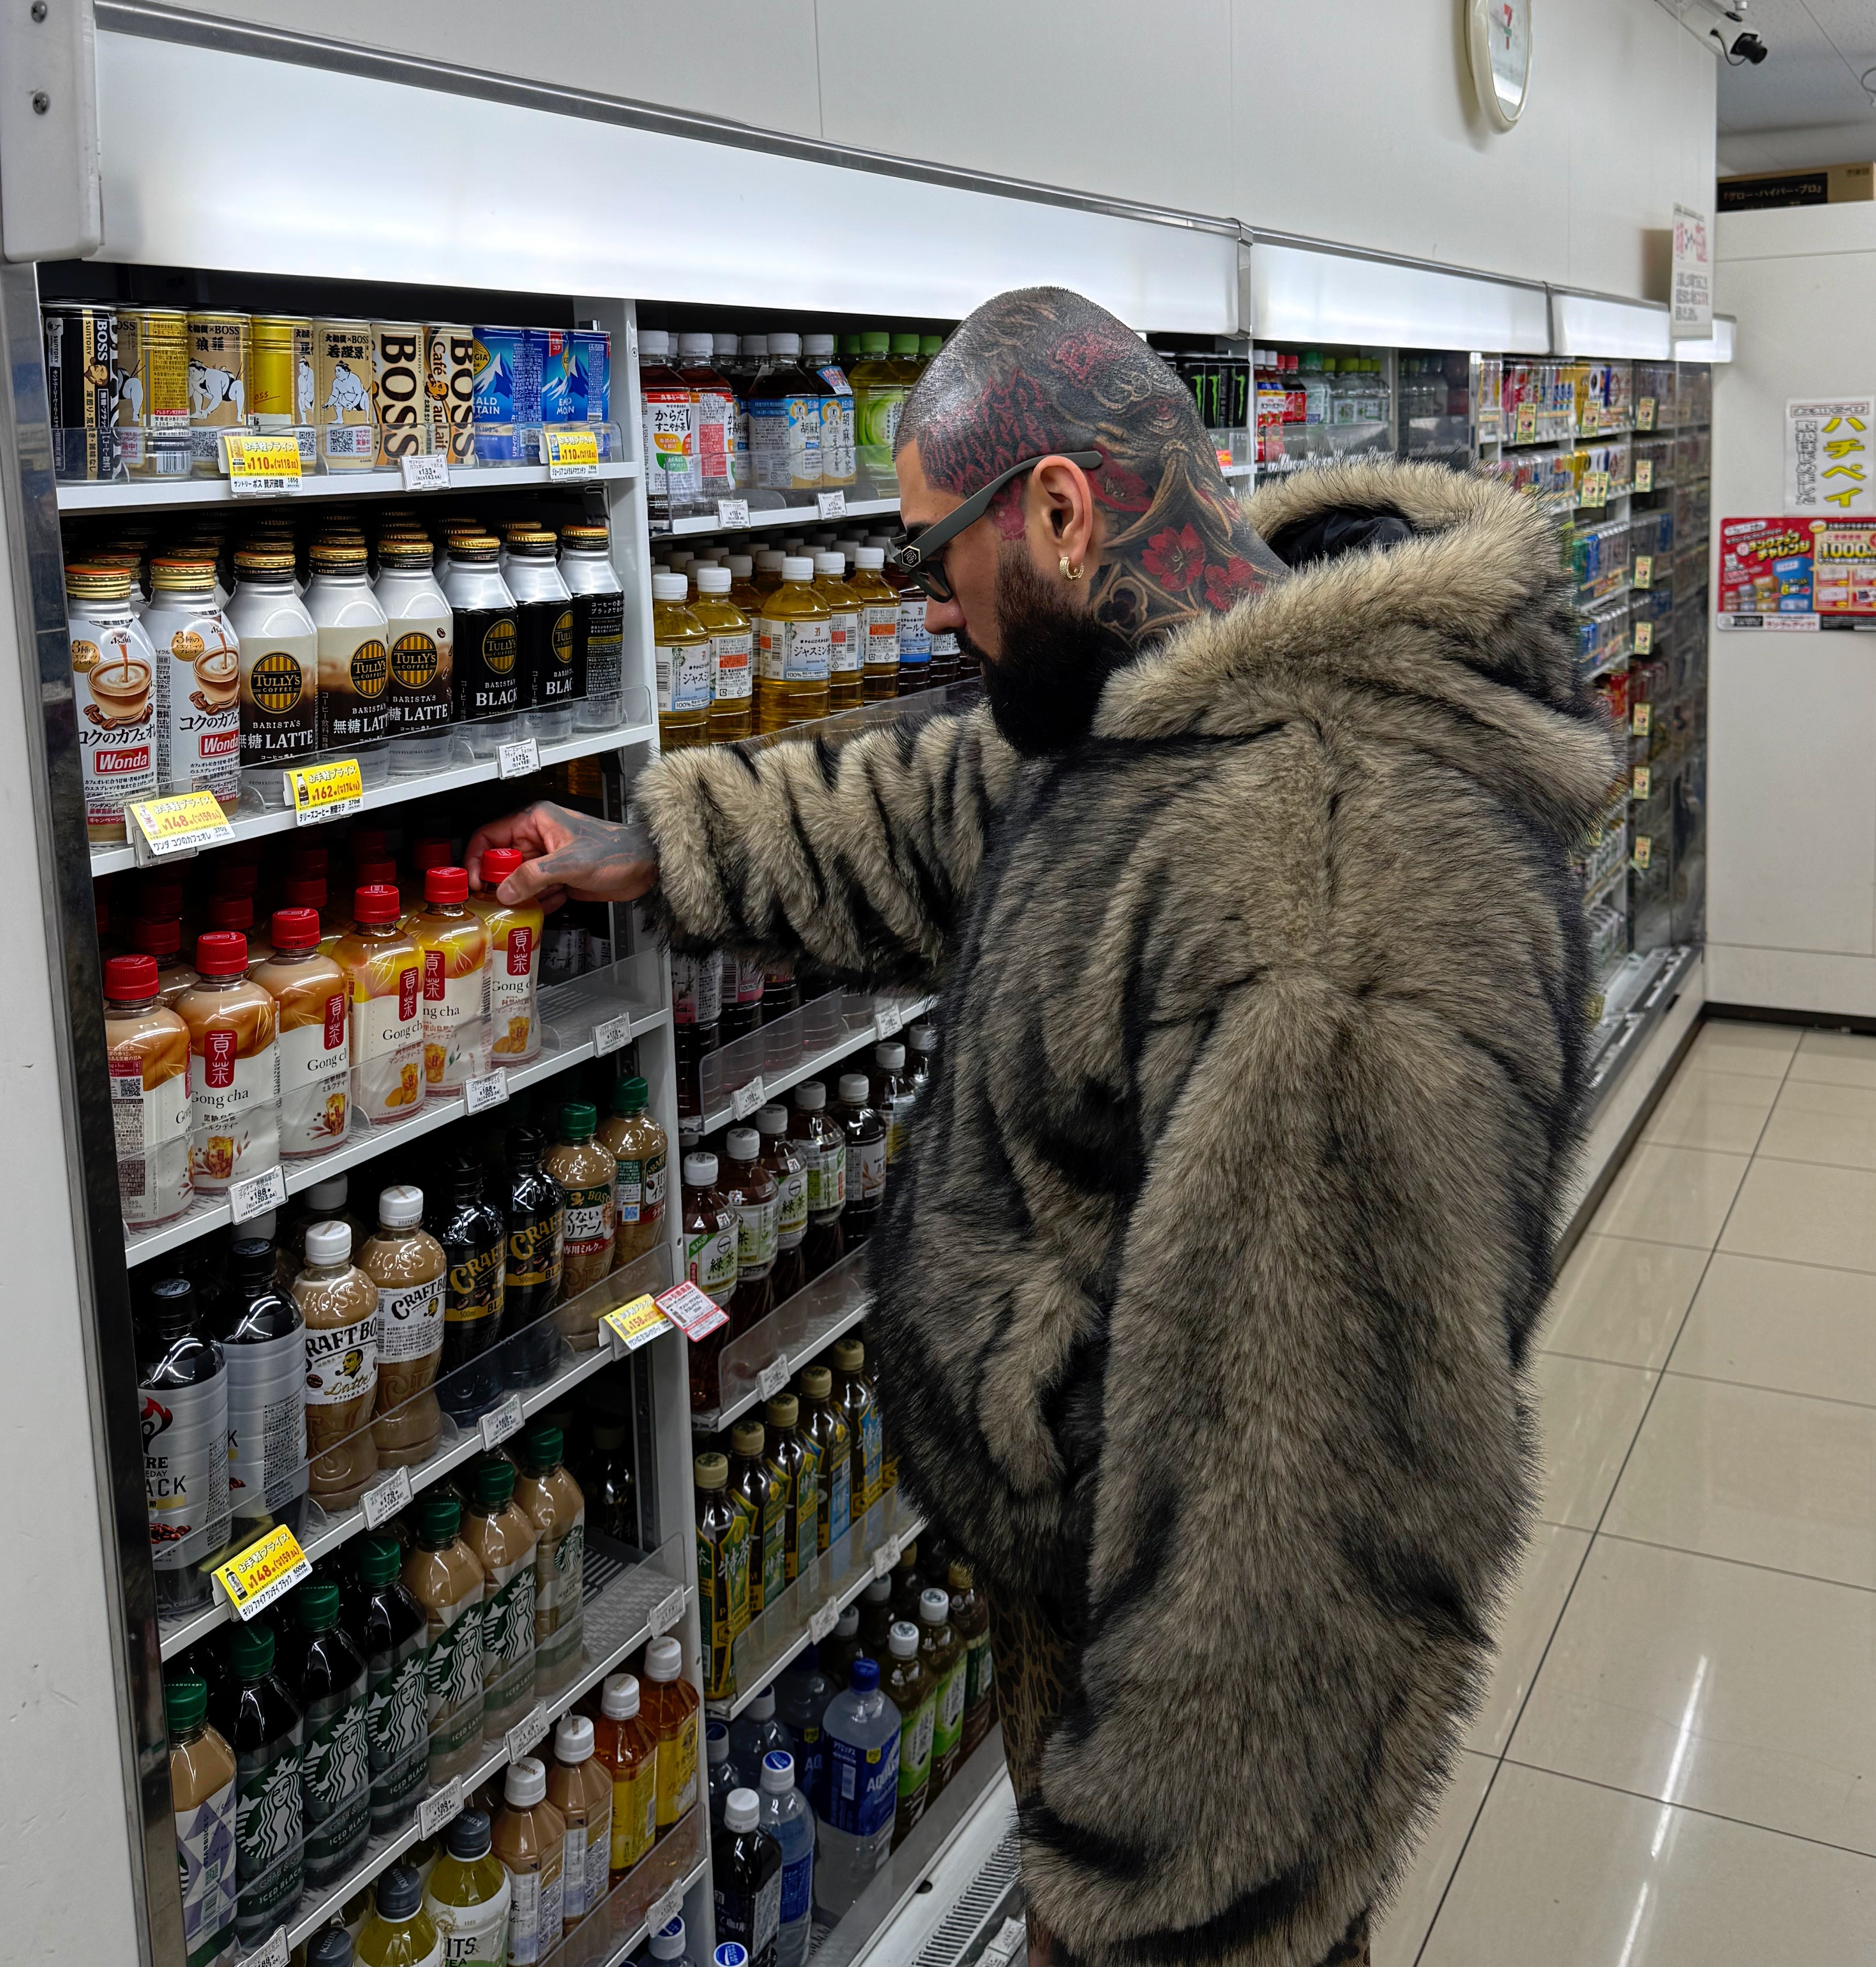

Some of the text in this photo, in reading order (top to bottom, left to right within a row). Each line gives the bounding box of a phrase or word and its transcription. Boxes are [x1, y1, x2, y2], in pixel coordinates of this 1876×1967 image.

[97, 321, 107, 361] BOSS
[327, 344, 364, 360] 若隆景
[381, 334, 419, 458] BOSS
[451, 336, 475, 458] BOSS
[433, 405, 443, 423] au
[655, 409, 685, 422] からだ
[655, 423, 687, 432] すこやか茶
[244, 441, 296, 452] お手軽プライス
[435, 425, 449, 450] Lait
[247, 457, 270, 470] ¥110
[1821, 417, 1866, 508] ハチペイ
[253, 479, 263, 488] ボス
[110, 635, 131, 645] Asahi
[393, 652, 437, 664] TULLY'S
[253, 673, 300, 687] TULLY'S
[546, 677, 573, 695] BLAC
[682, 671, 709, 685] ジャスミ
[392, 694, 437, 703] BARISTA'S
[476, 687, 518, 706] BLACK
[179, 711, 239, 733] コクのカフェ
[388, 703, 448, 722] 糖 LATTE
[253, 719, 301, 729] BARISTA'S
[333, 712, 389, 734] 無糖 LATT
[204, 734, 239, 754] Wonda
[265, 729, 314, 749] LATTE
[99, 751, 148, 770] Wonda
[309, 766, 356, 783] お手軽プライス
[312, 786, 333, 801] ¥162
[153, 796, 213, 814] お手軽プライス
[162, 815, 189, 831] ¥148
[299, 809, 329, 822] タリーズコーヒー
[153, 839, 169, 851] ワンダ
[171, 832, 212, 847] コクのカフェオレ
[512, 929, 529, 973] 貢茶
[425, 953, 441, 998] 貢茶
[402, 969, 417, 1019] 貢茶
[492, 981, 523, 993] Gong
[328, 995, 343, 1047] 貢茶
[423, 1005, 459, 1019] ng cha
[383, 1020, 423, 1041] Gong ch
[210, 1033, 233, 1085] 貢茶
[307, 1054, 337, 1071] Gong
[191, 1089, 249, 1109] Gong cha
[250, 1188, 267, 1201] ¥188
[567, 1211, 599, 1224] くない
[567, 1220, 602, 1237] リアーノ
[391, 1280, 437, 1321] CRAFT
[360, 1316, 377, 1341] BO
[324, 1371, 374, 1396] Latte
[145, 1456, 168, 1469] RE
[145, 1470, 167, 1478] EDAY
[145, 1475, 187, 1498] ACK
[238, 1532, 290, 1573] お手軽プライス
[248, 1565, 272, 1589] ¥148
[242, 1603, 254, 1617] キリン
[252, 1593, 265, 1609] ファイア
[265, 1586, 279, 1600] ワンデイ
[278, 1575, 293, 1590] ブラック
[521, 1673, 535, 1689] LATT
[465, 1717, 482, 1732] LATT
[390, 1778, 407, 1794] ICED
[329, 1810, 369, 1846] ICED BLACK
[259, 1865, 302, 1904] ICED BLACK
[391, 1868, 409, 1889] KIRIN
[318, 1929, 339, 1954] KIRIN
[447, 1937, 476, 1958] ITS
